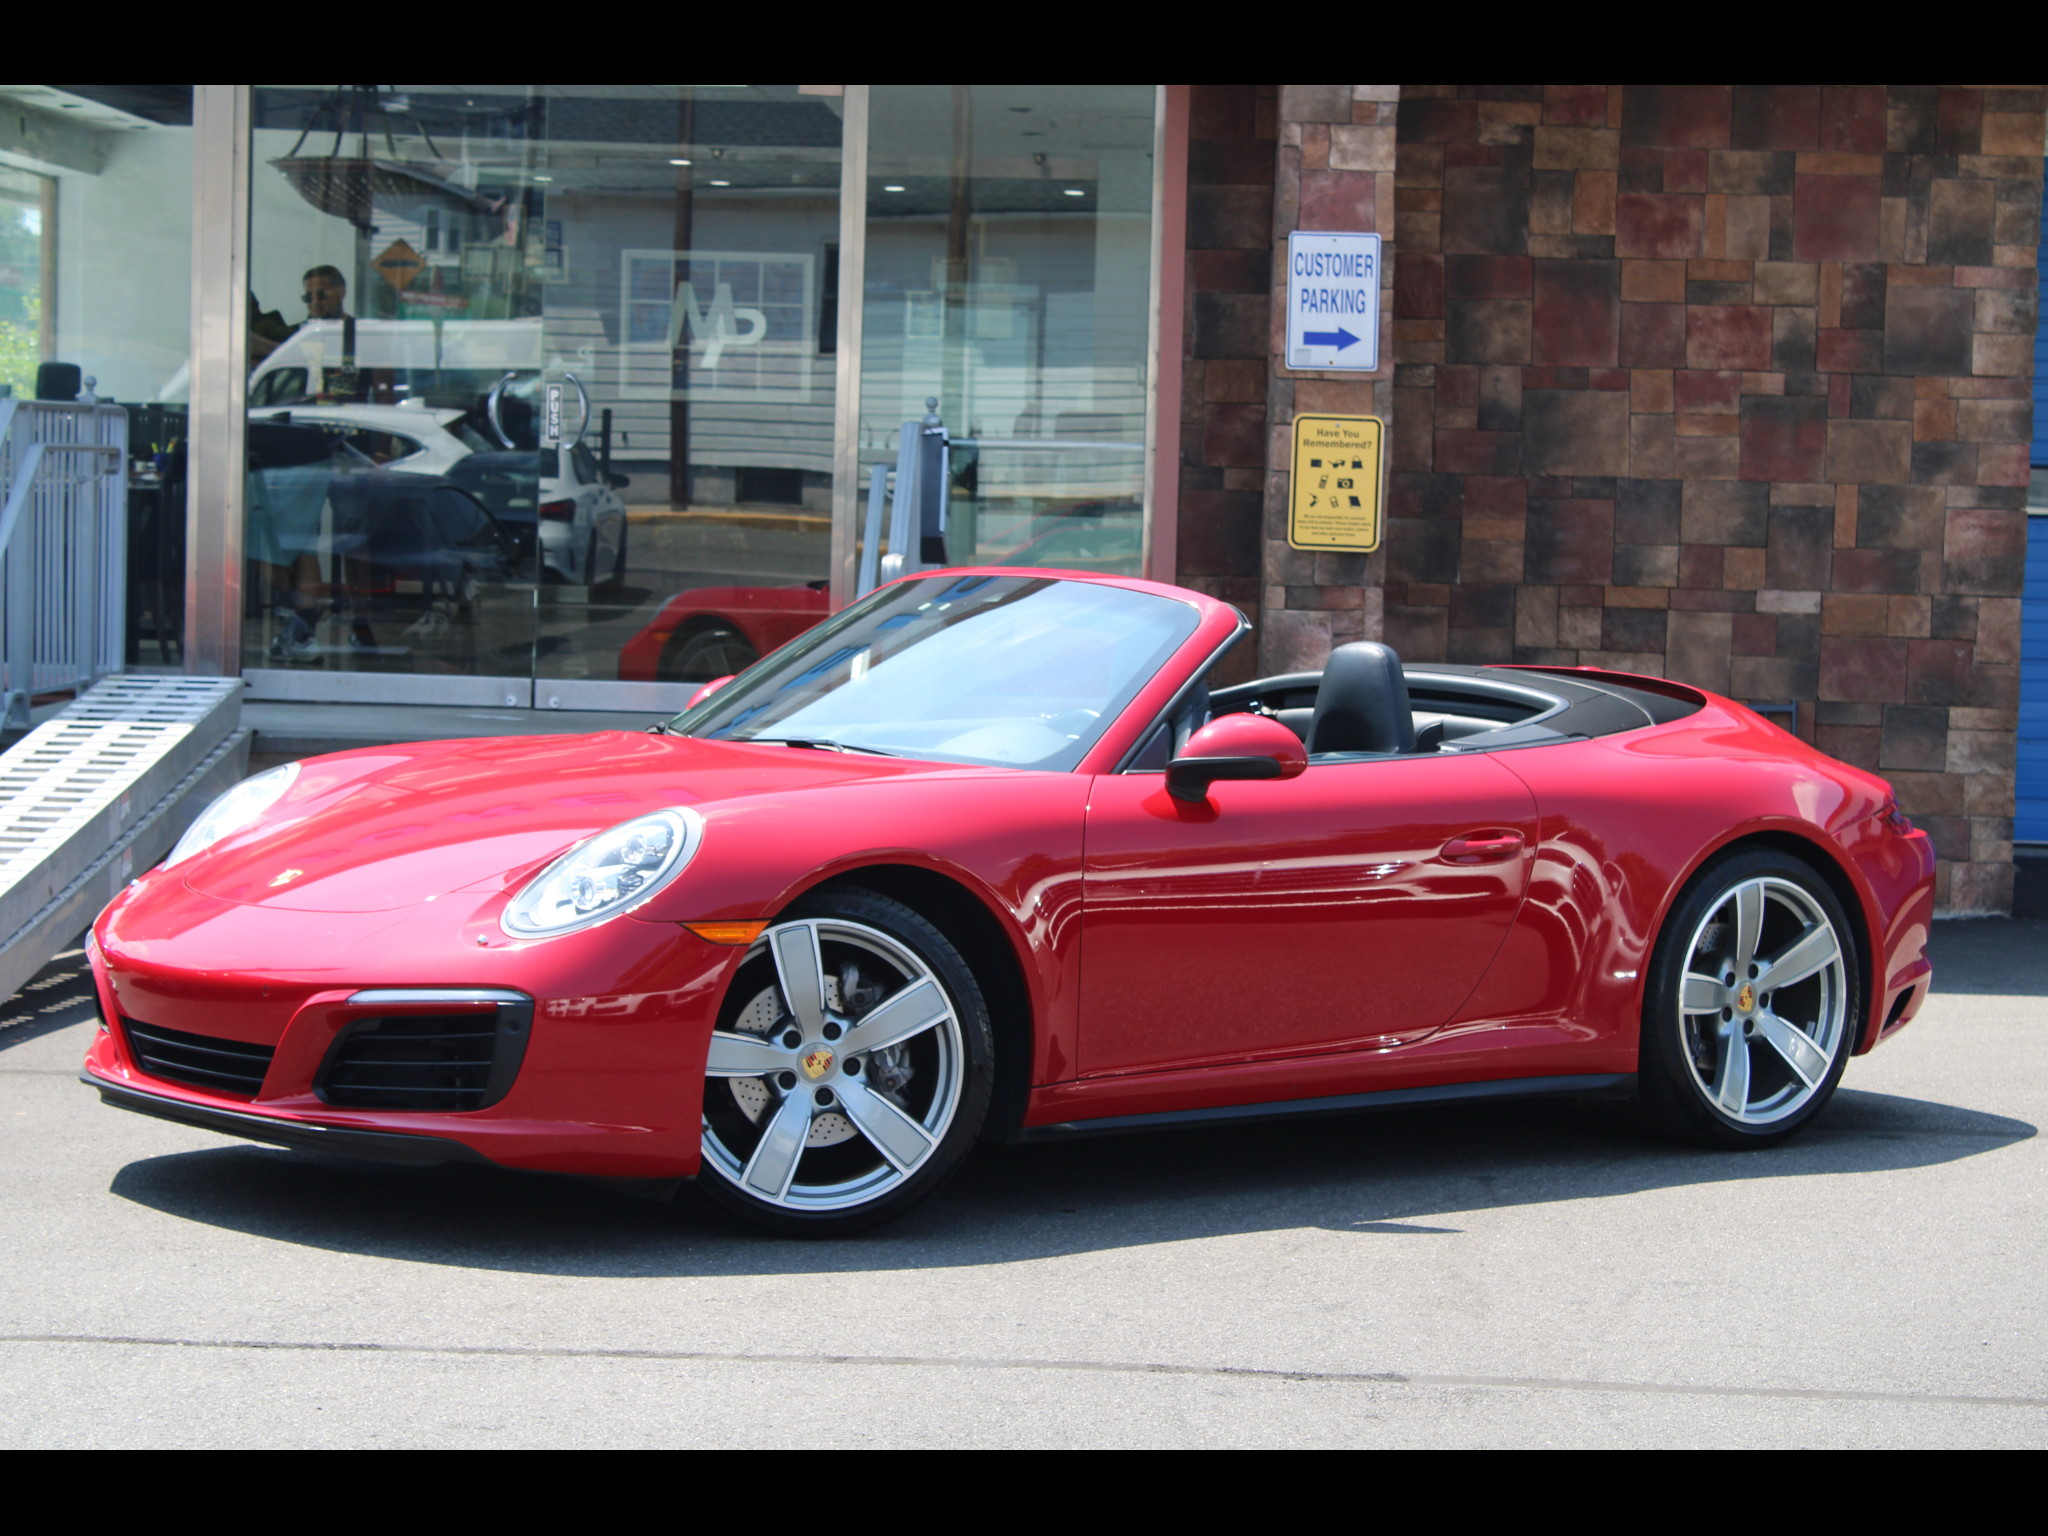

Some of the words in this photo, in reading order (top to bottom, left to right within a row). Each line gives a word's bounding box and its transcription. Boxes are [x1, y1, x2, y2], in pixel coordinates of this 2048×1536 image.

[1294, 252, 1374, 278] CUSTOMER
[1300, 288, 1366, 315] PARKING
[550, 389, 560, 437] PUSH
[1303, 438, 1372, 450] Remembered?
[1316, 428, 1340, 438] Have
[1342, 429, 1360, 438] You
